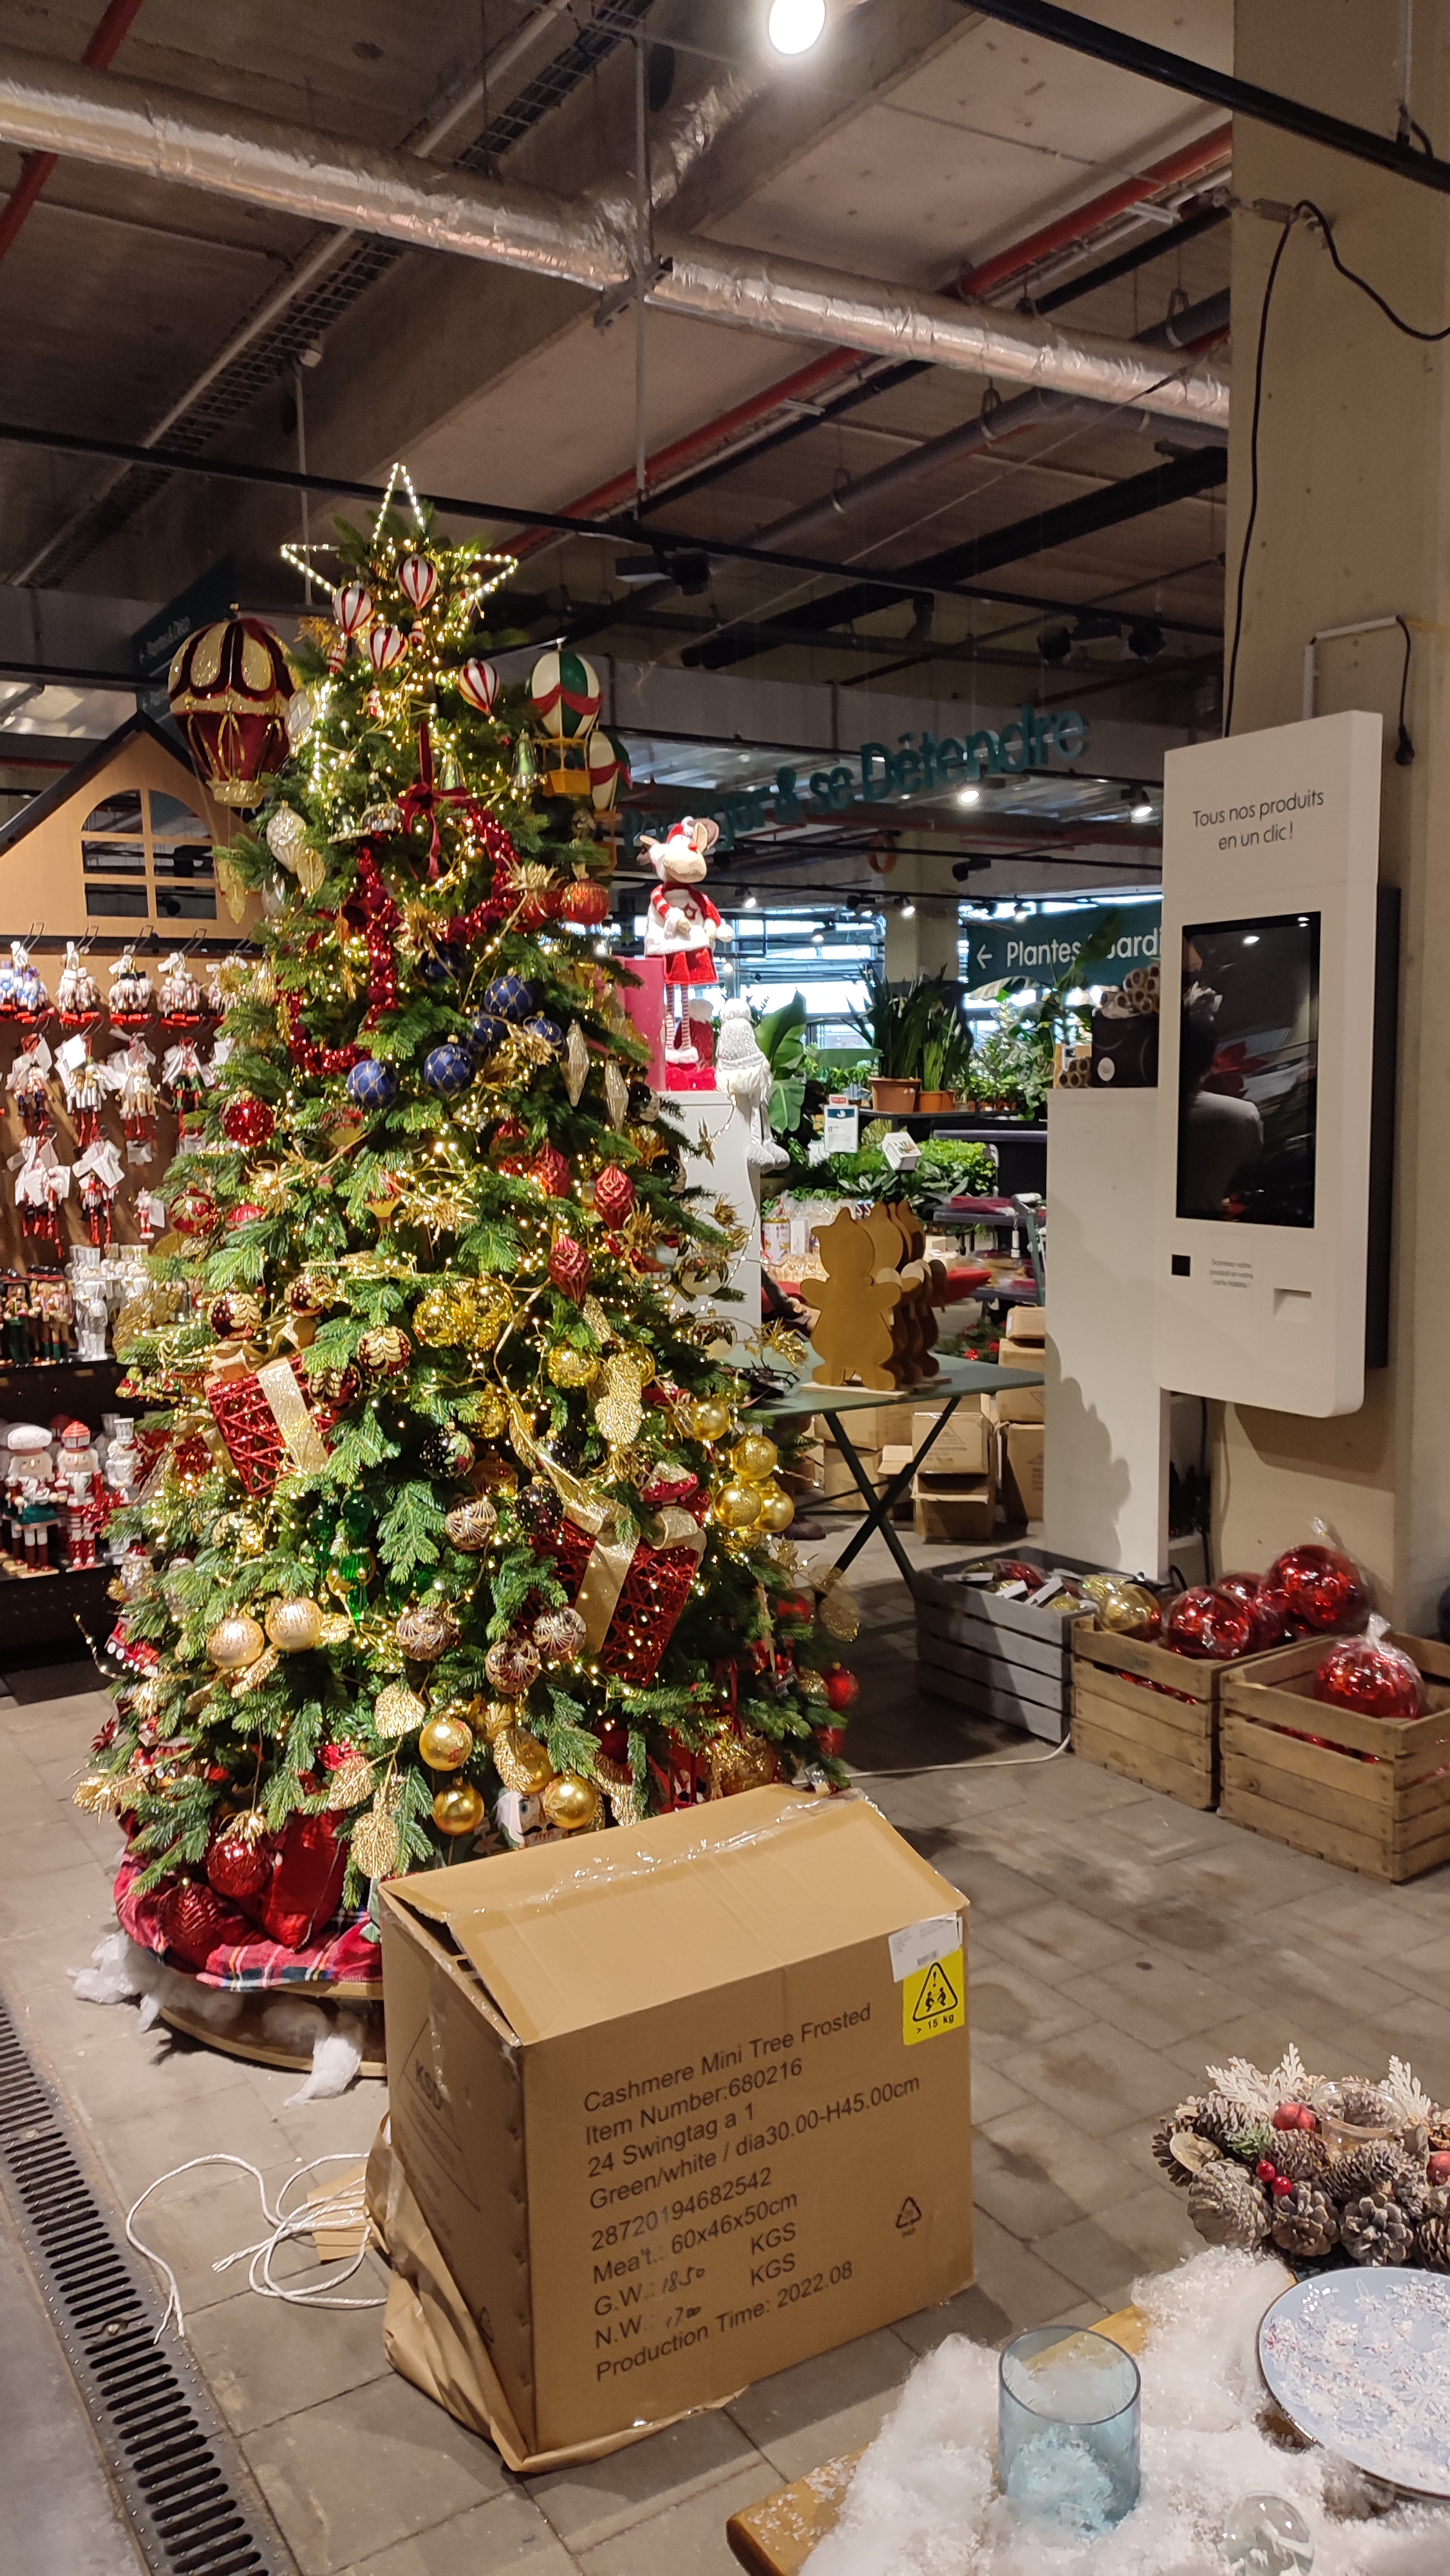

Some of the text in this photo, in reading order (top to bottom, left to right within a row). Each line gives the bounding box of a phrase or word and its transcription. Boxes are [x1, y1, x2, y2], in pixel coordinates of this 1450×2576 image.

[861, 704, 1089, 802] Détendre
[1193, 790, 1324, 828] Tous nos produits
[1218, 835, 1237, 851] en
[1241, 831, 1259, 847] un
[1006, 939, 1082, 968] Plantes
[943, 2014, 954, 2024] kg
[583, 2001, 871, 2112] Cashmere Mini Tree Frosted
[585, 2058, 802, 2146] Item Number:680216
[588, 2101, 753, 2179] 24 Swingtag a 1
[590, 2152, 717, 2209] Green/white
[735, 2076, 920, 2157] dia30.00-H45.00cm
[591, 2166, 772, 2251] 28720194682542
[671, 2193, 798, 2255] 60x46x50cm
[750, 2221, 797, 2255] KGS
[750, 2253, 796, 2287] KGS
[596, 2260, 853, 2382] Production Time: 2022.08
